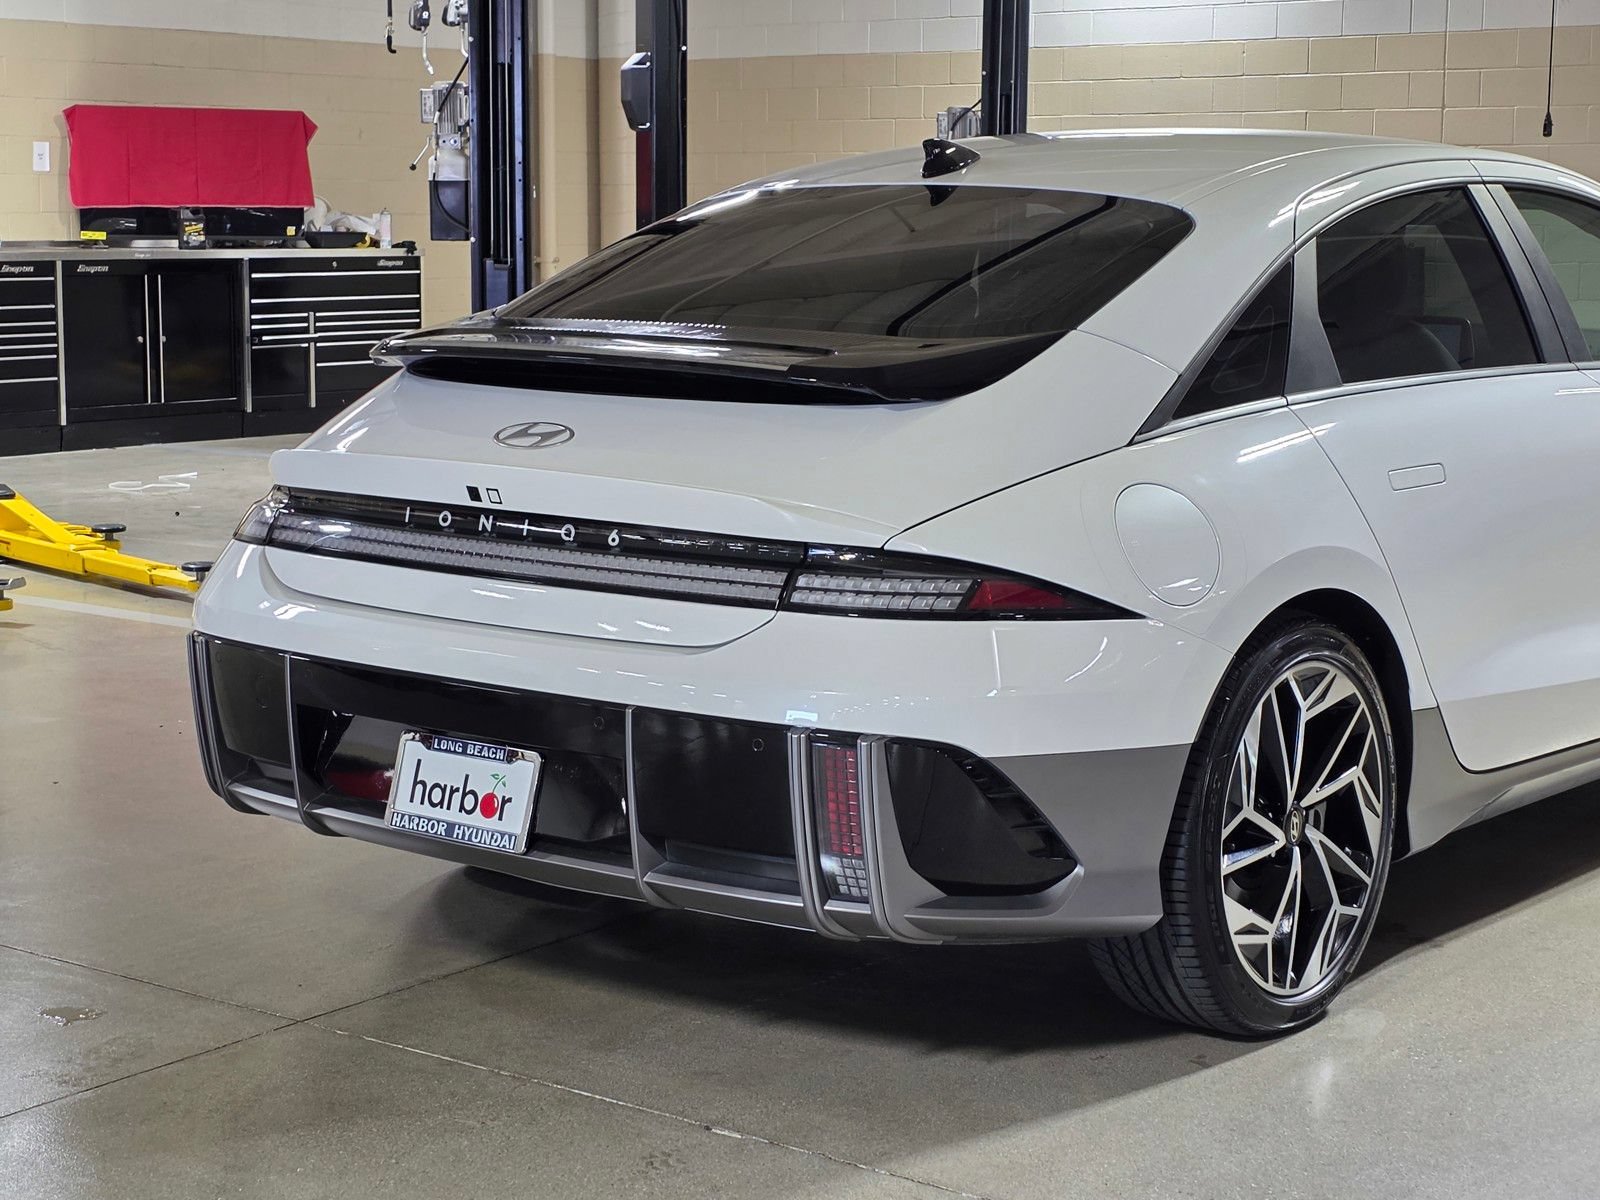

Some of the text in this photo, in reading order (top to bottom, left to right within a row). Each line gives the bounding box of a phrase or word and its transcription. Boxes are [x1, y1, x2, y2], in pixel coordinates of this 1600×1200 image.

[404, 506, 621, 547] IONIQ 6
[433, 738, 506, 760] LONG BEACH
[409, 758, 513, 821] harbor
[391, 812, 518, 850] HARBOR HYUNDAI
